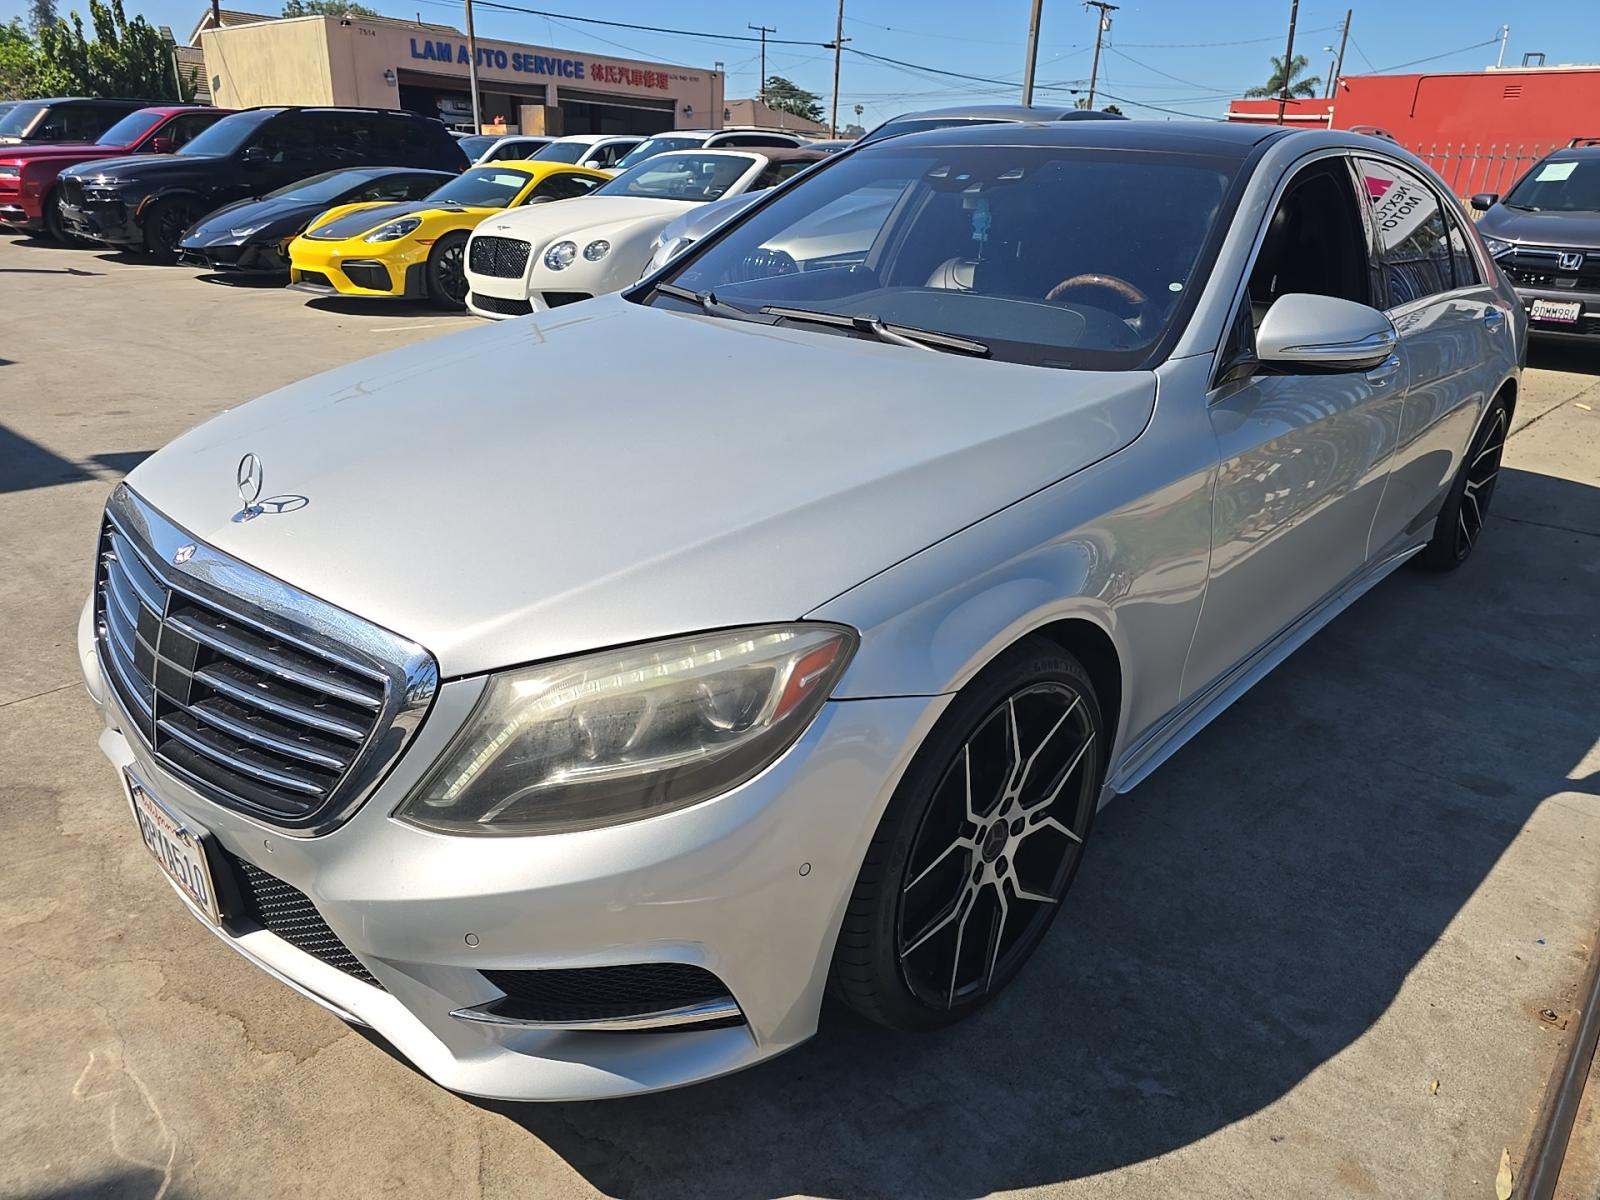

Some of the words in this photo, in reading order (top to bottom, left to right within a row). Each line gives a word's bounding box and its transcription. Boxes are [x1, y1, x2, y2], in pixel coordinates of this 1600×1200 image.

[410, 38, 452, 63] LAM
[457, 45, 508, 70] AUTO
[512, 52, 585, 80] SERVICE
